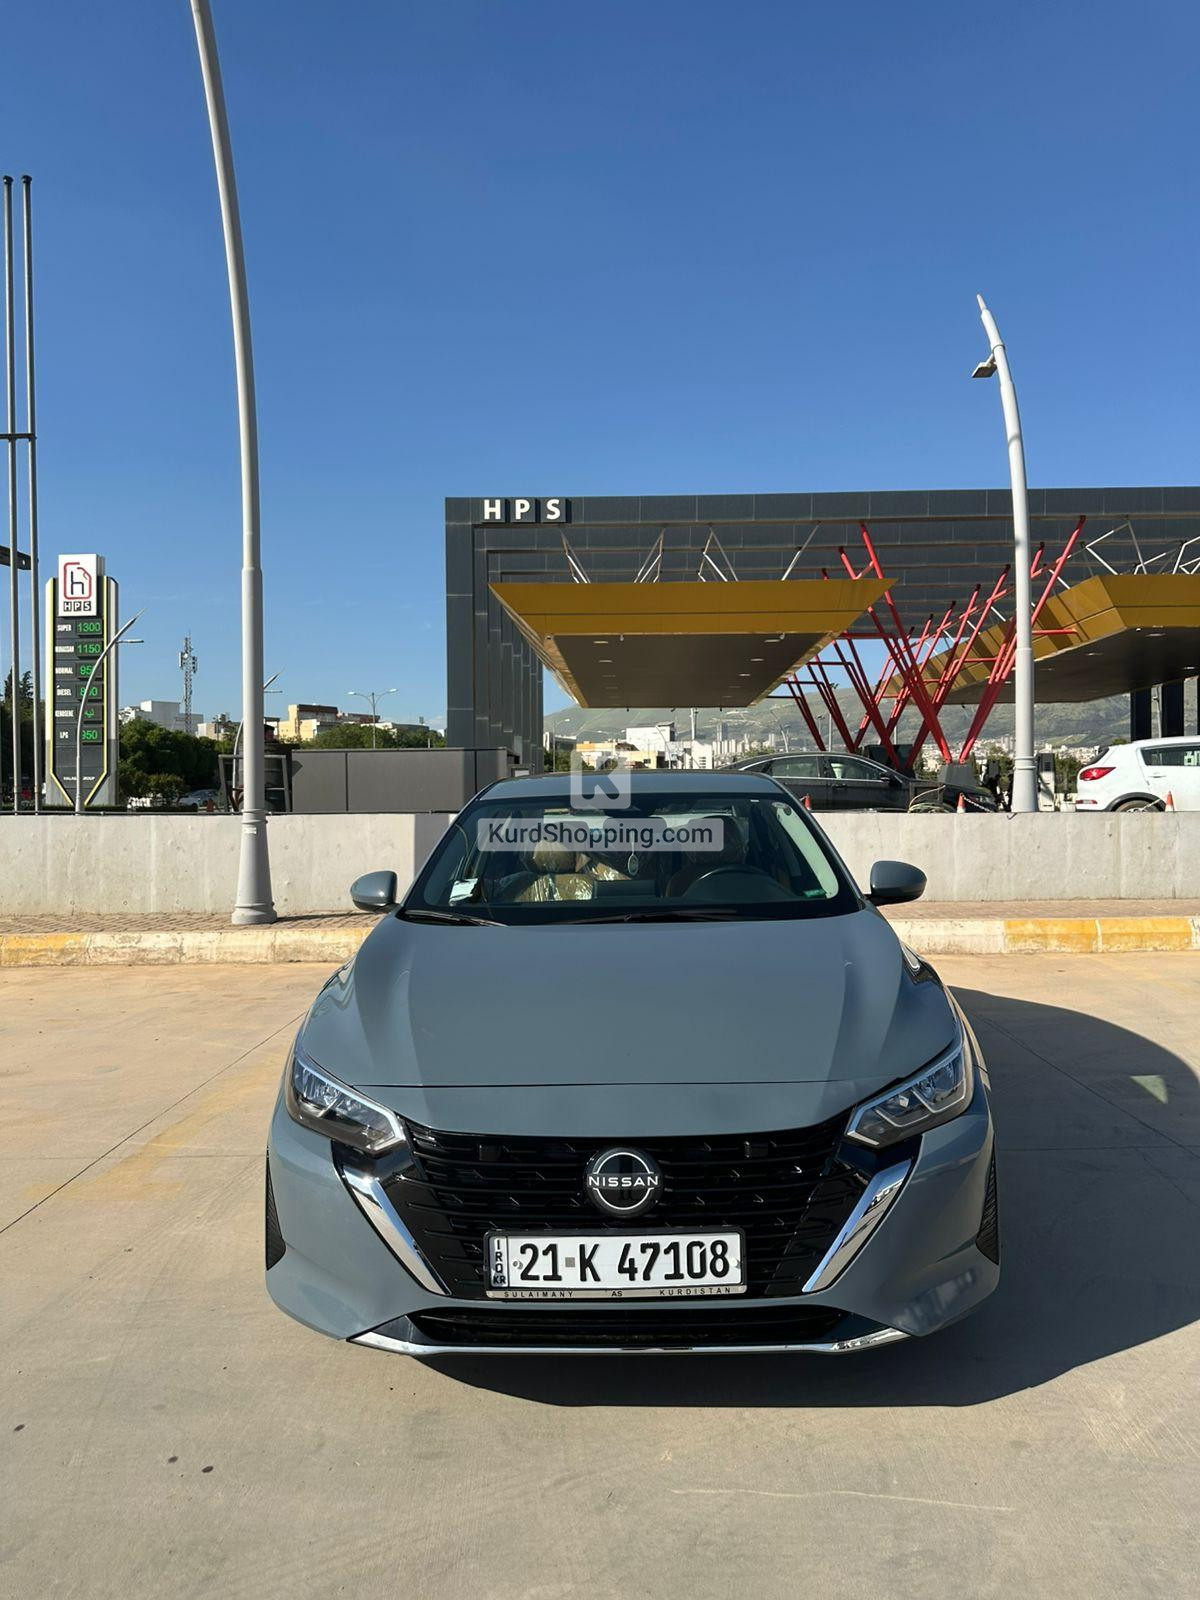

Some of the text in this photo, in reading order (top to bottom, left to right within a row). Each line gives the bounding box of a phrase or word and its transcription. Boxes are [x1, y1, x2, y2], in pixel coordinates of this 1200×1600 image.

[483, 498, 561, 520] HPS
[63, 601, 92, 612] HPS
[77, 622, 101, 633] 1300
[77, 643, 101, 654] 1150
[588, 1175, 659, 1188] NISSAN
[519, 1239, 730, 1282] 21 K 47108
[493, 1275, 506, 1285] KR
[503, 1290, 574, 1299] SULAIMANY
[659, 1286, 731, 1296] KURDISTAN
